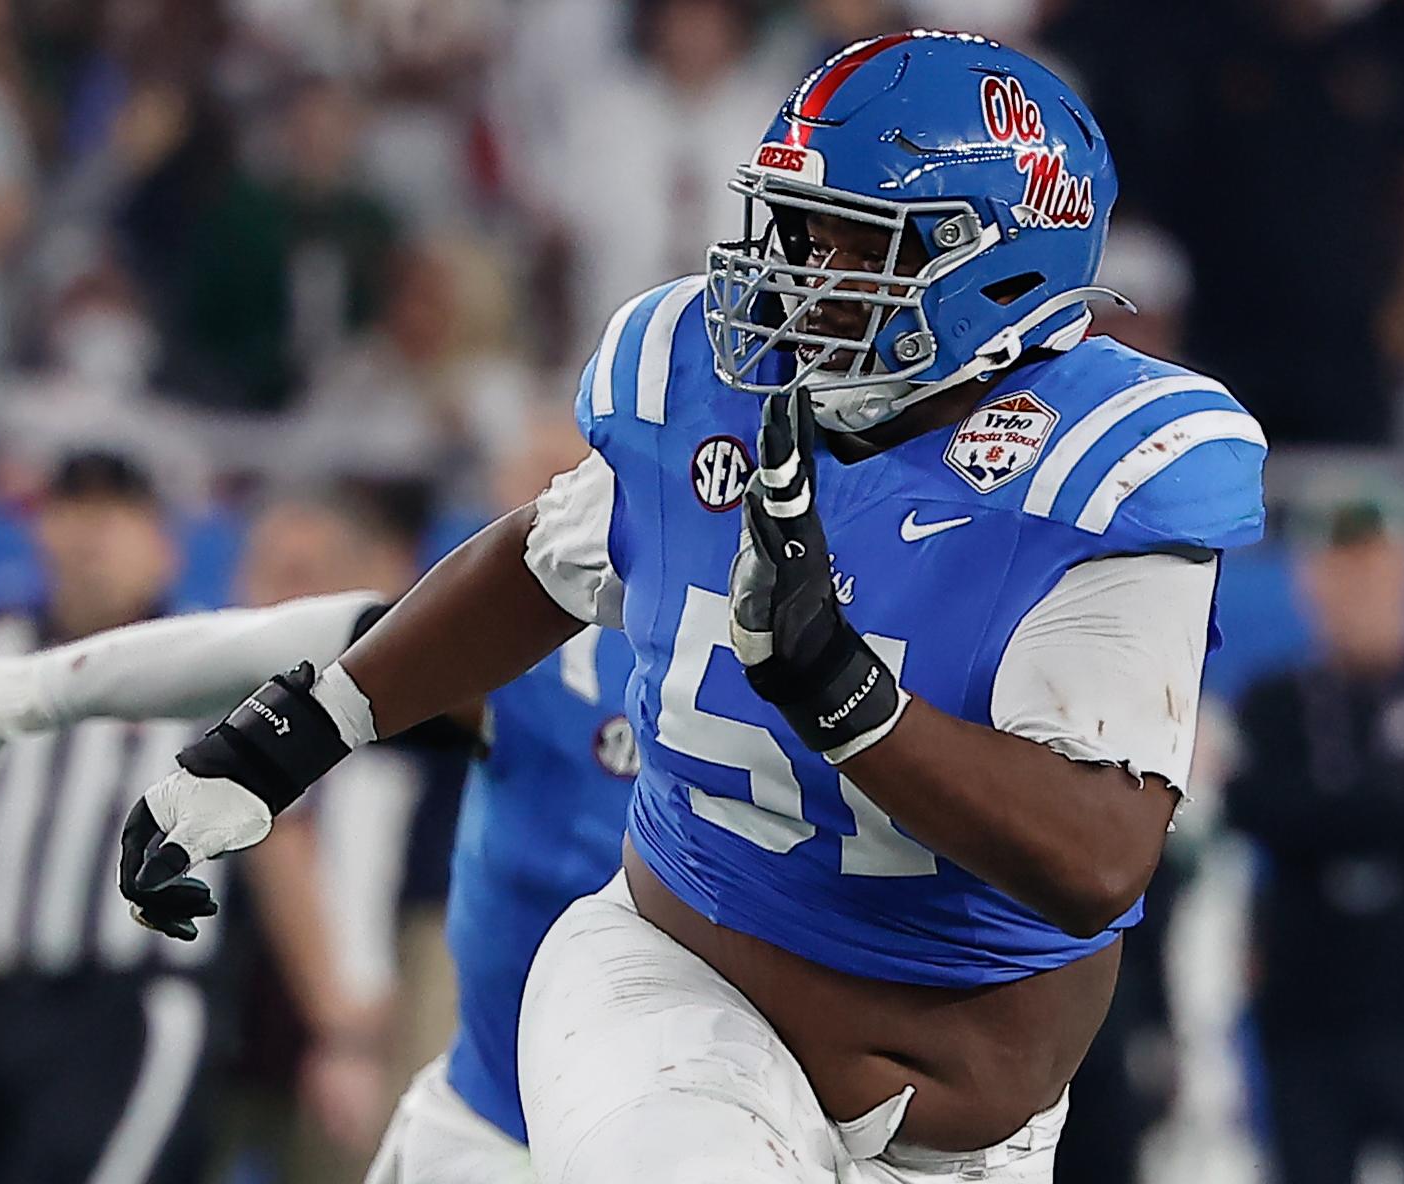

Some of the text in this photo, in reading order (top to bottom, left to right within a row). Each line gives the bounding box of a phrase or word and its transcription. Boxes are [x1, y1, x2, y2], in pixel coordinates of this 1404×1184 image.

[980, 75, 1046, 145] Ole
[1015, 150, 1095, 230] Miss
[985, 413, 1033, 430] Vrbo
[695, 440, 748, 506] SEC
[827, 665, 880, 724] MUELLER
